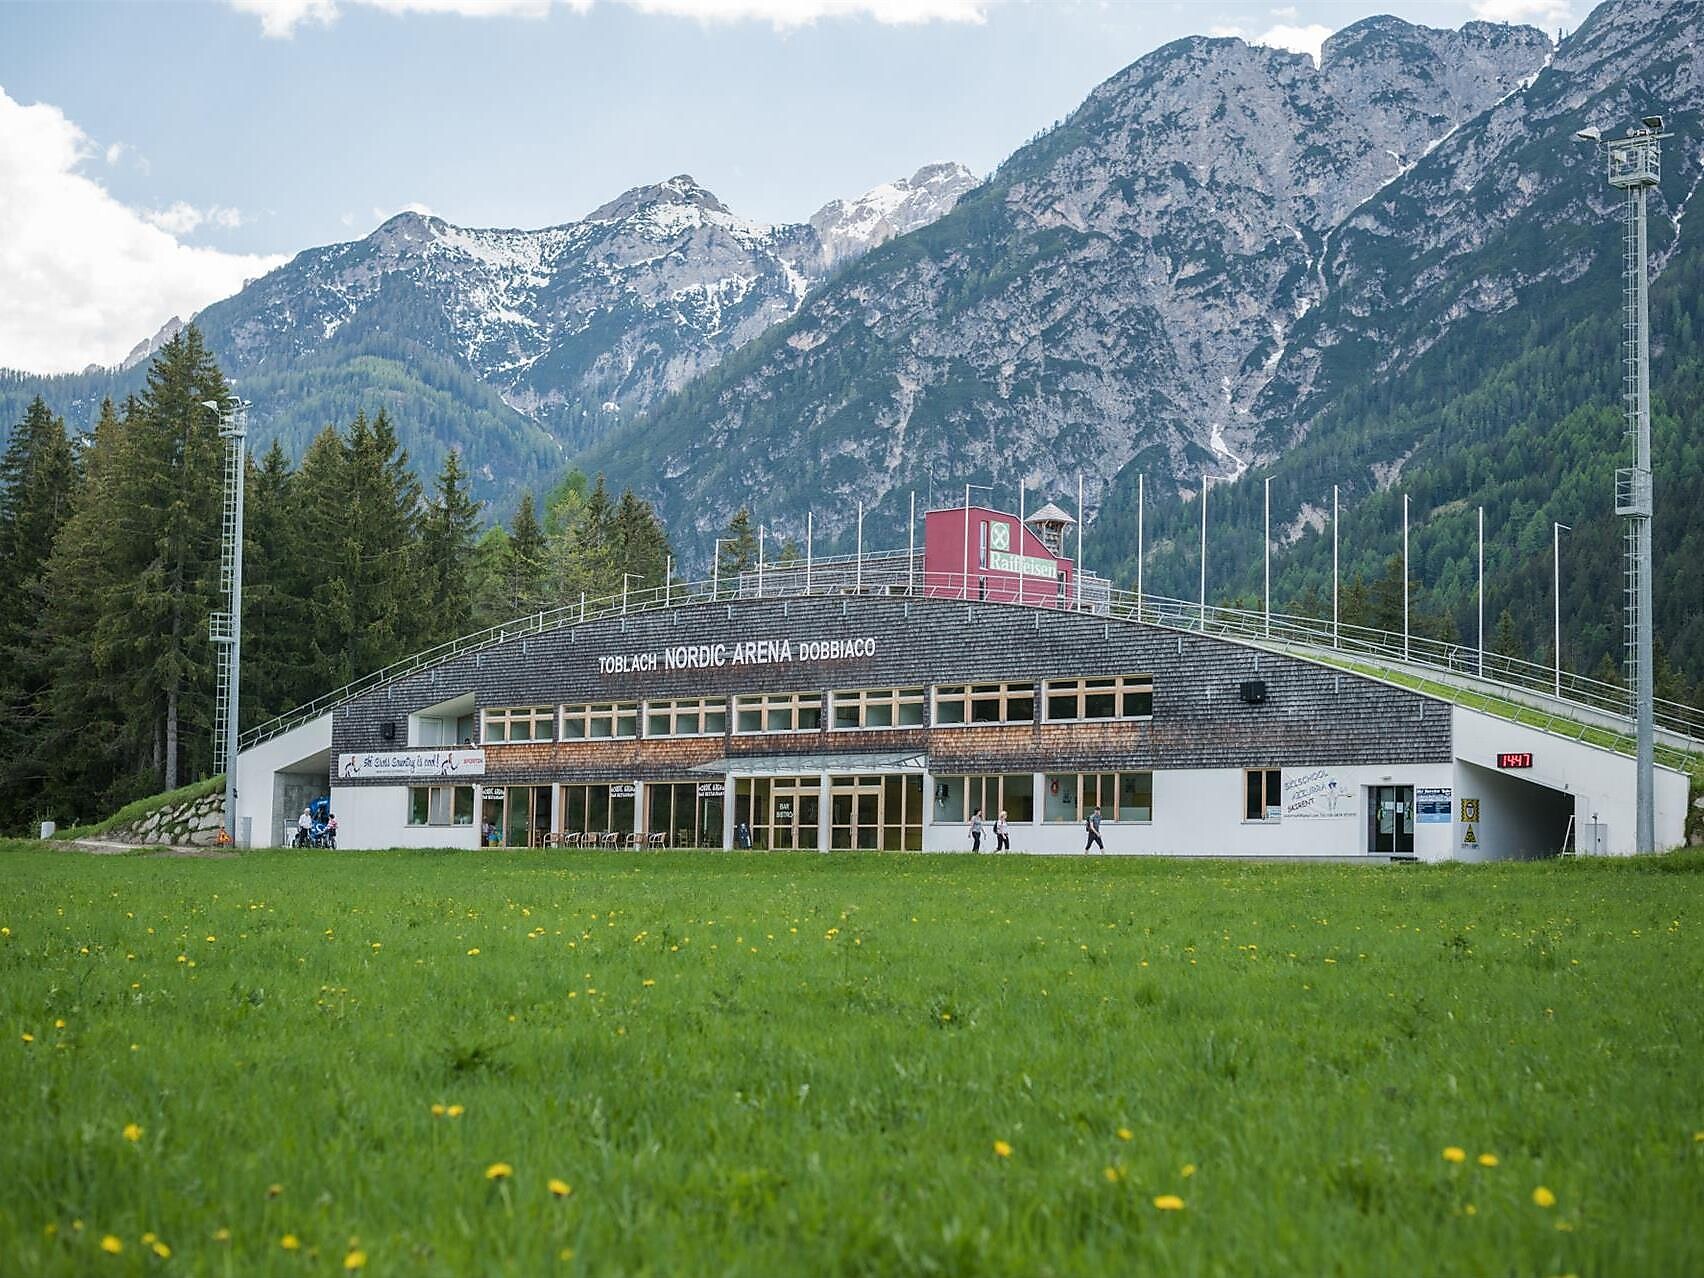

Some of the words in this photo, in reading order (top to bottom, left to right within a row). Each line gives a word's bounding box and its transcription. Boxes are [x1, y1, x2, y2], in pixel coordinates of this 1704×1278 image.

[599, 653, 657, 674] TOBLACH
[665, 643, 726, 670] NORDIC
[731, 639, 792, 665] ARENA
[799, 638, 876, 661] DOBBIACO
